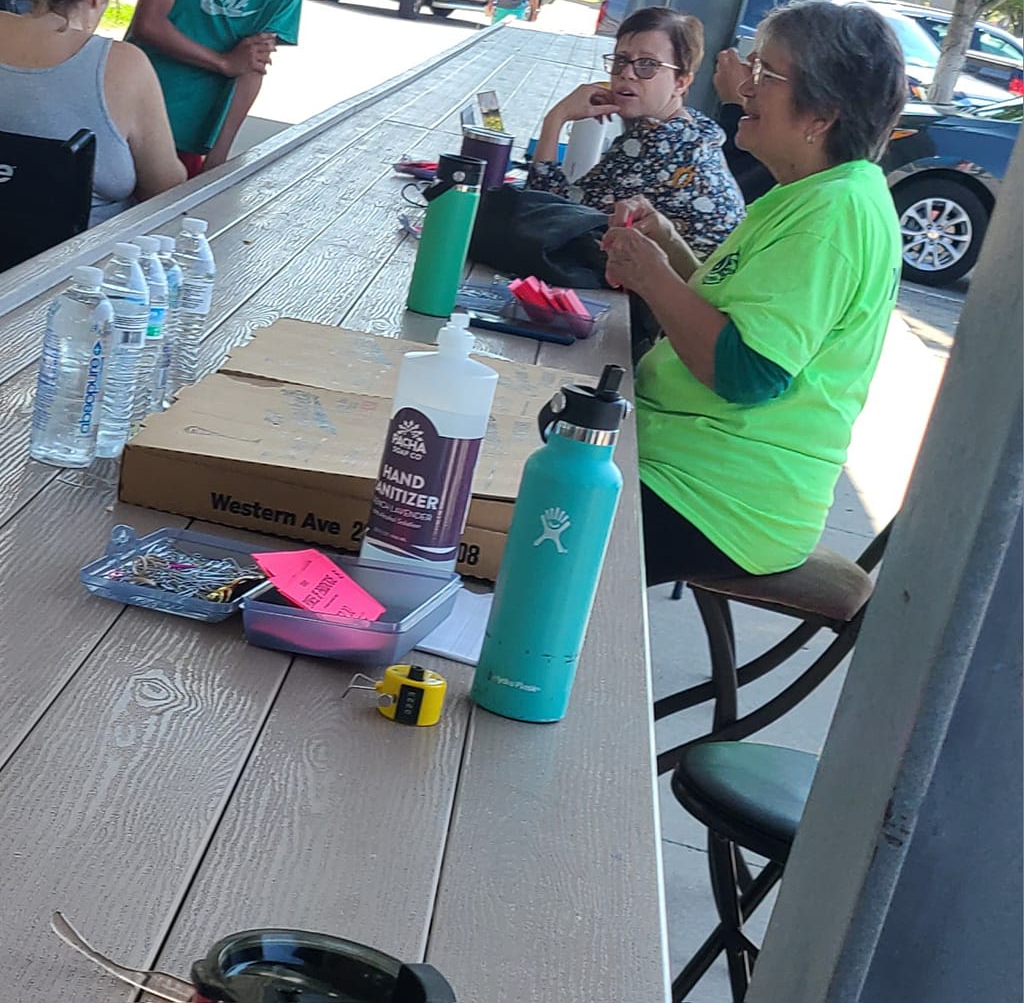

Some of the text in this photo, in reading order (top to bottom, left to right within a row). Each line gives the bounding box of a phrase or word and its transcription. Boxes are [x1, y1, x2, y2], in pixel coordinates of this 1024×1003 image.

[391, 432, 427, 455] PACHA
[382, 464, 425, 489] HAND
[376, 480, 439, 510] ANITIZER
[210, 492, 297, 526] Western
[301, 512, 341, 535] Ave
